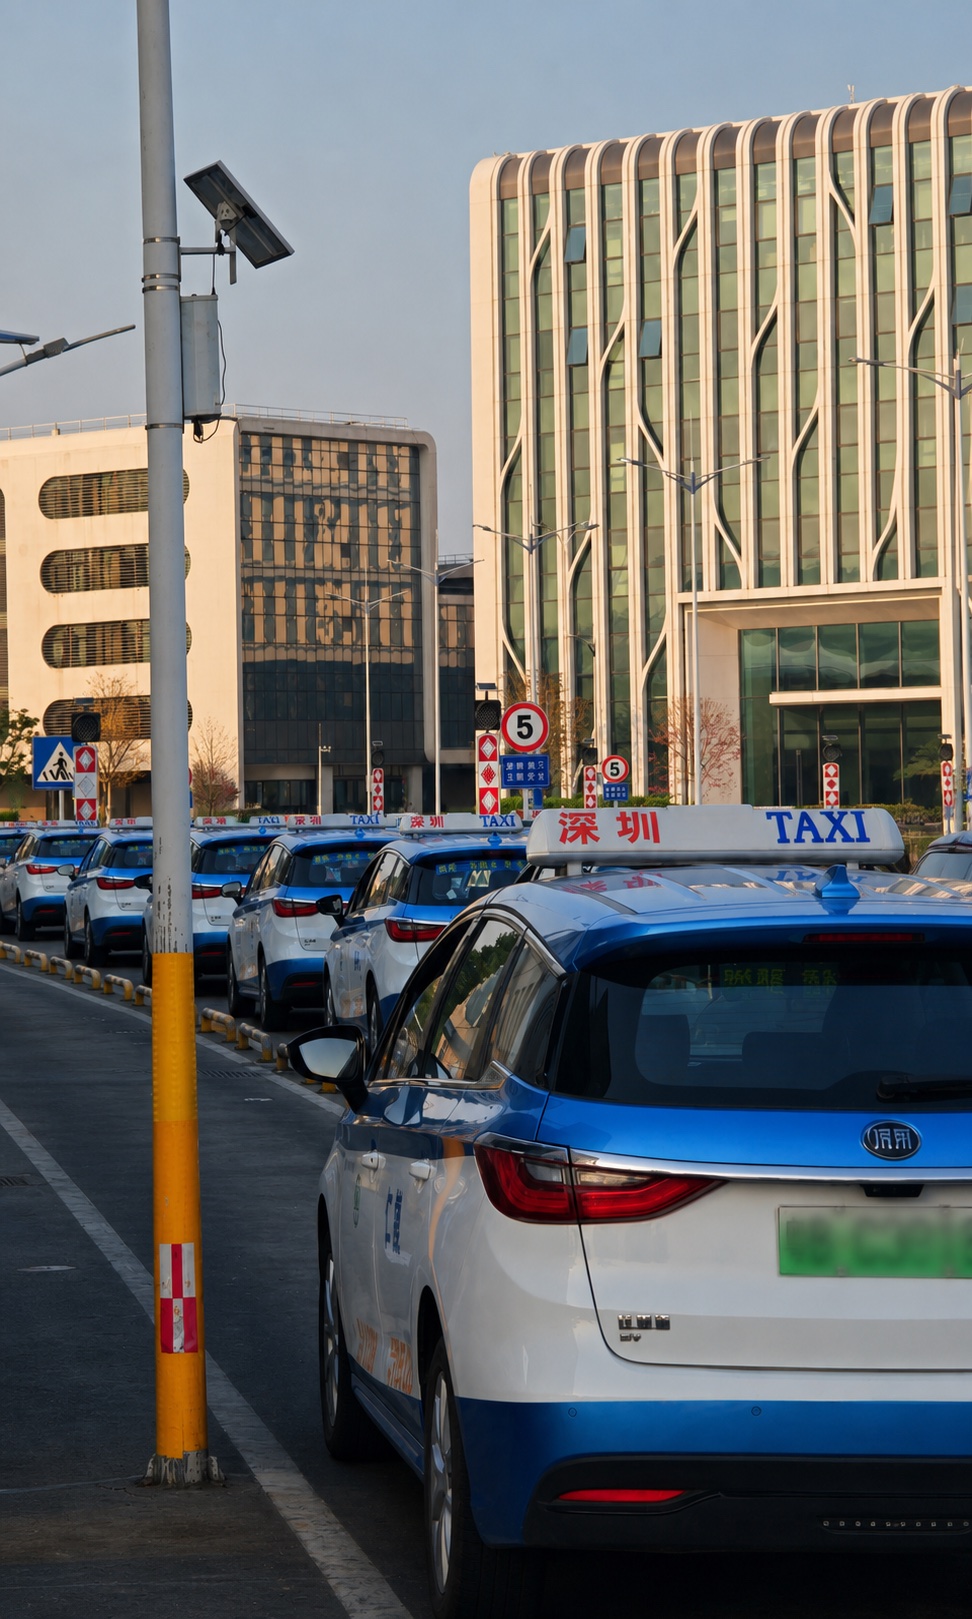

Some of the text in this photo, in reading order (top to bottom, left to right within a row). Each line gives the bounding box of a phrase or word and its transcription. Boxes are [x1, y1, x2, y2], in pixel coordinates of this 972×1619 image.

[516, 714, 534, 740] 5
[610, 761, 620, 777] 5
[349, 813, 380, 825] TAXI
[479, 814, 516, 828] TAXI
[558, 810, 661, 845] 深圳
[766, 810, 871, 844] TAXI
